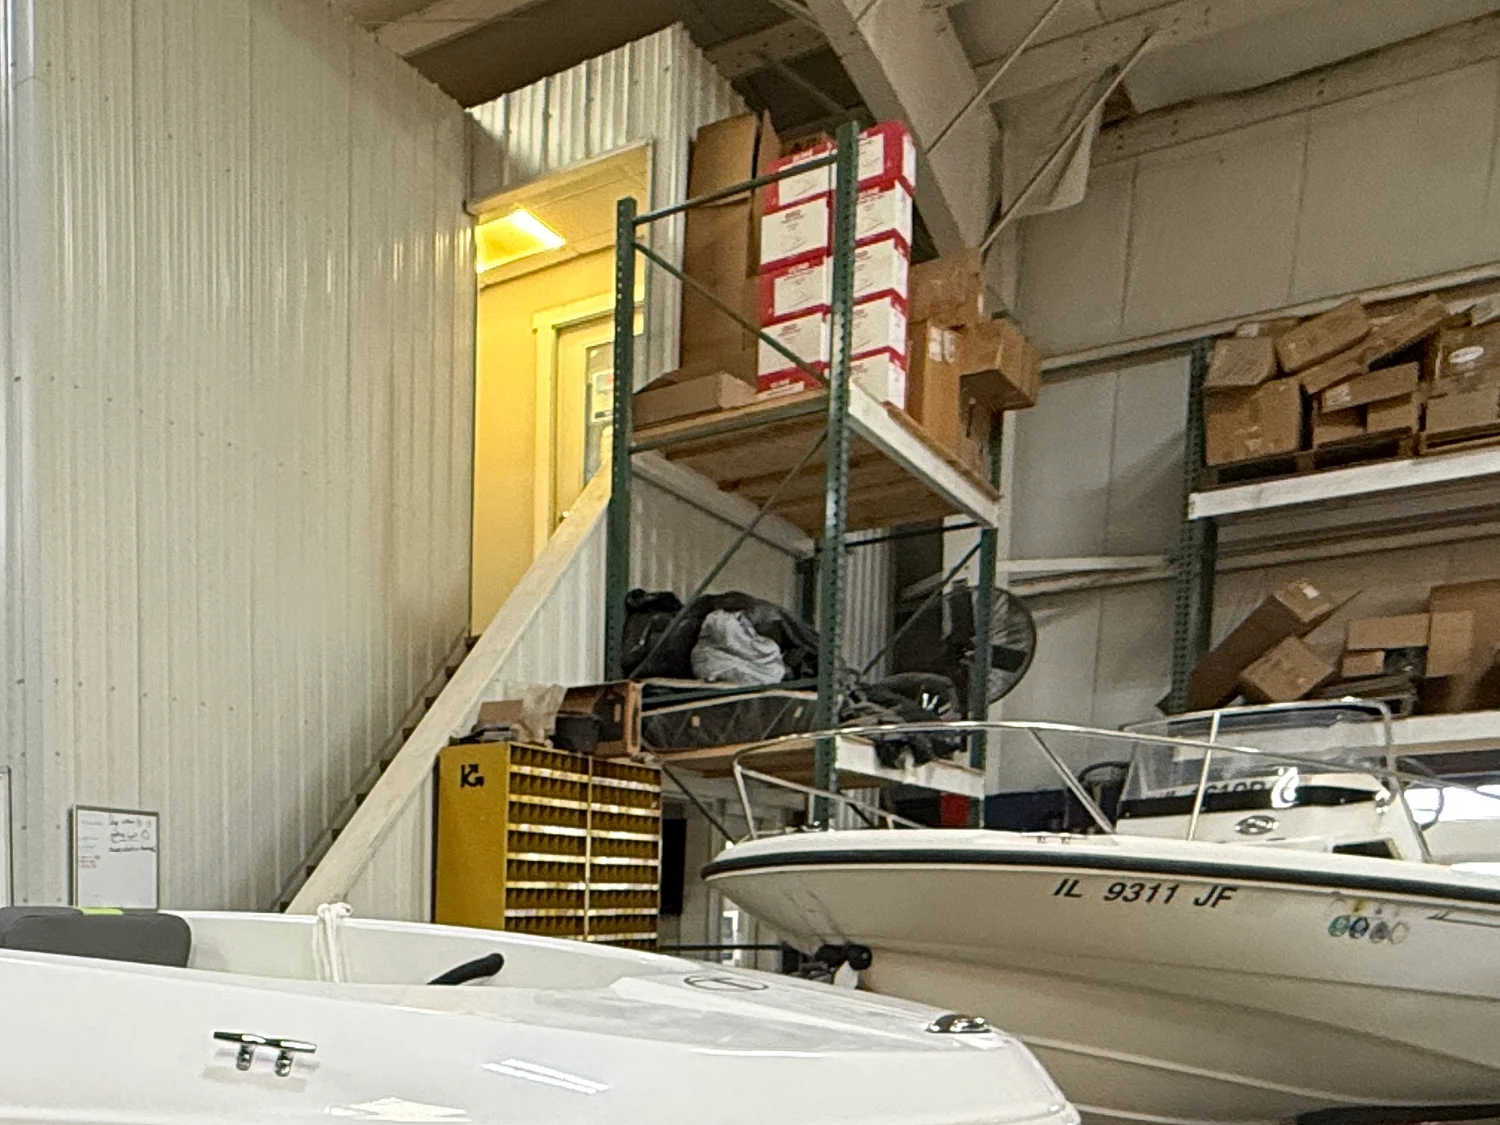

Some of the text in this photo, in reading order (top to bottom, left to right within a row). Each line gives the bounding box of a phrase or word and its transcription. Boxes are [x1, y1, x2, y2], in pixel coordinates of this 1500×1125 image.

[1053, 878, 1238, 909] IL 9311 JF
